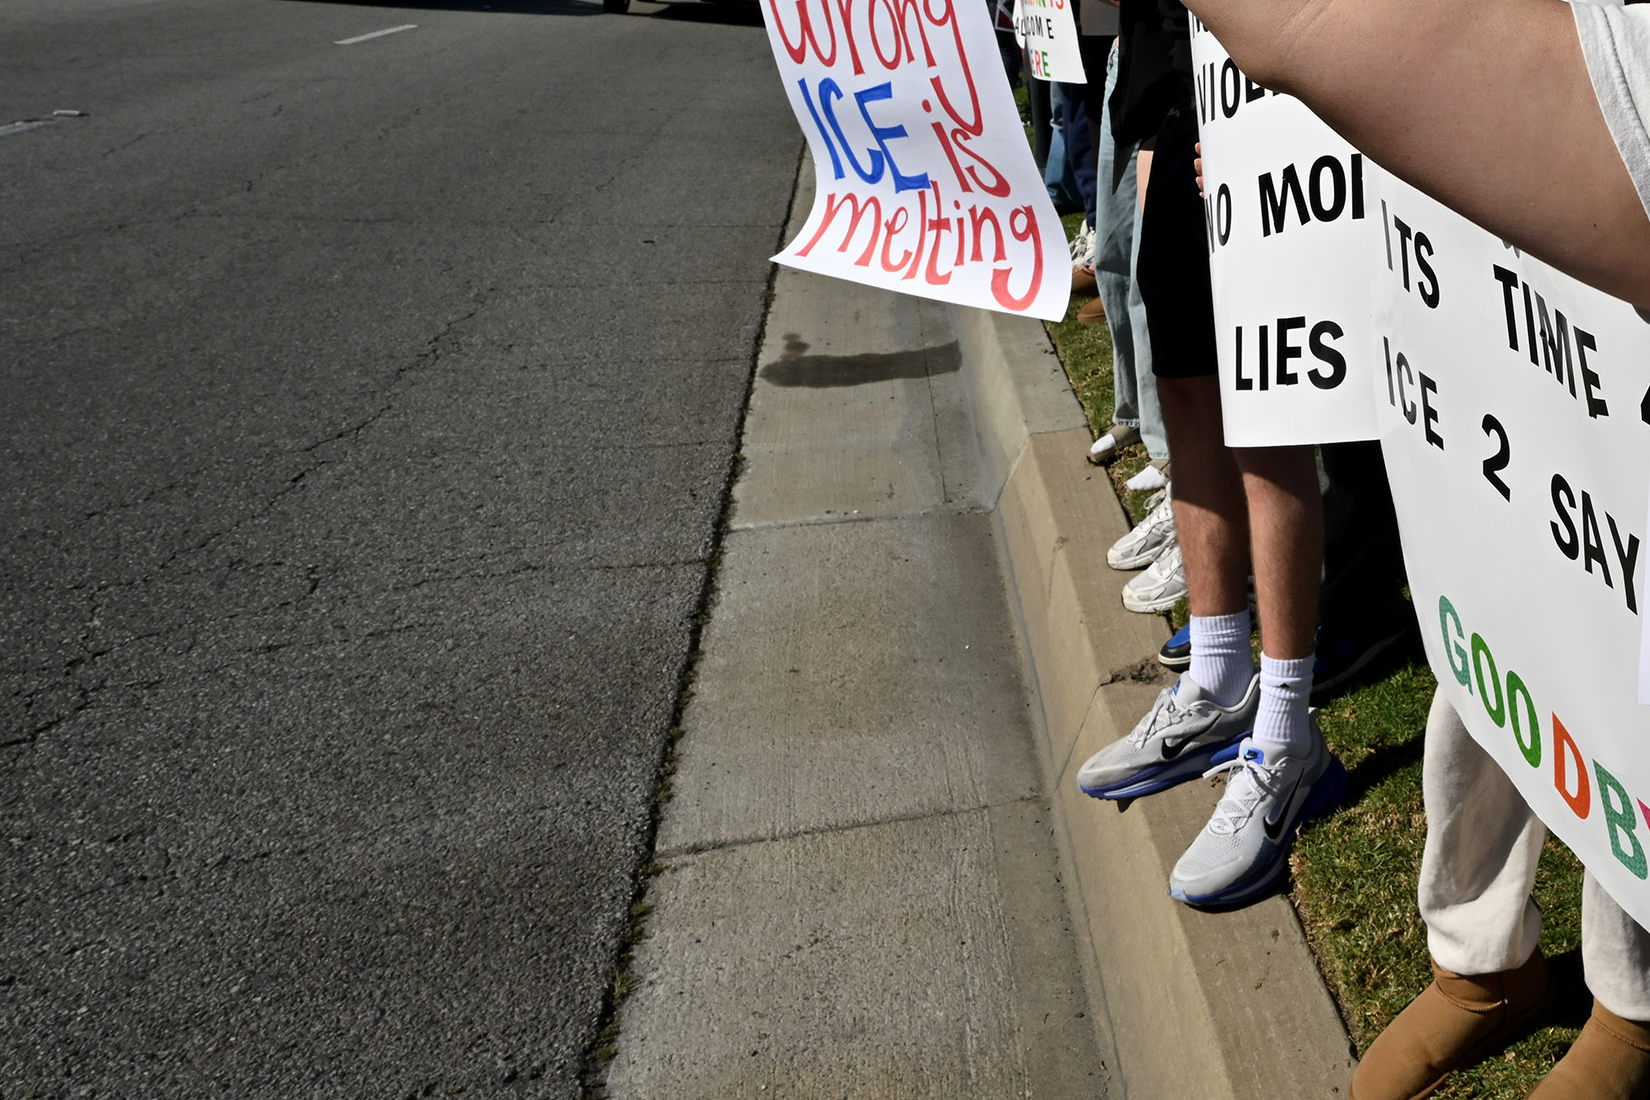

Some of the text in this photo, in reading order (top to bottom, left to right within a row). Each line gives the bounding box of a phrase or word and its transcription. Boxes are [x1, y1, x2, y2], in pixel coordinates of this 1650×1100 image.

[797, 77, 932, 194] ICE
[922, 98, 1011, 198] is
[794, 180, 1044, 312] melting
[1258, 153, 1365, 238] MO
[1235, 316, 1347, 391] LIES
[1380, 198, 1609, 419] ITS TIME
[1383, 335, 1640, 616] ICE 2 SAY
